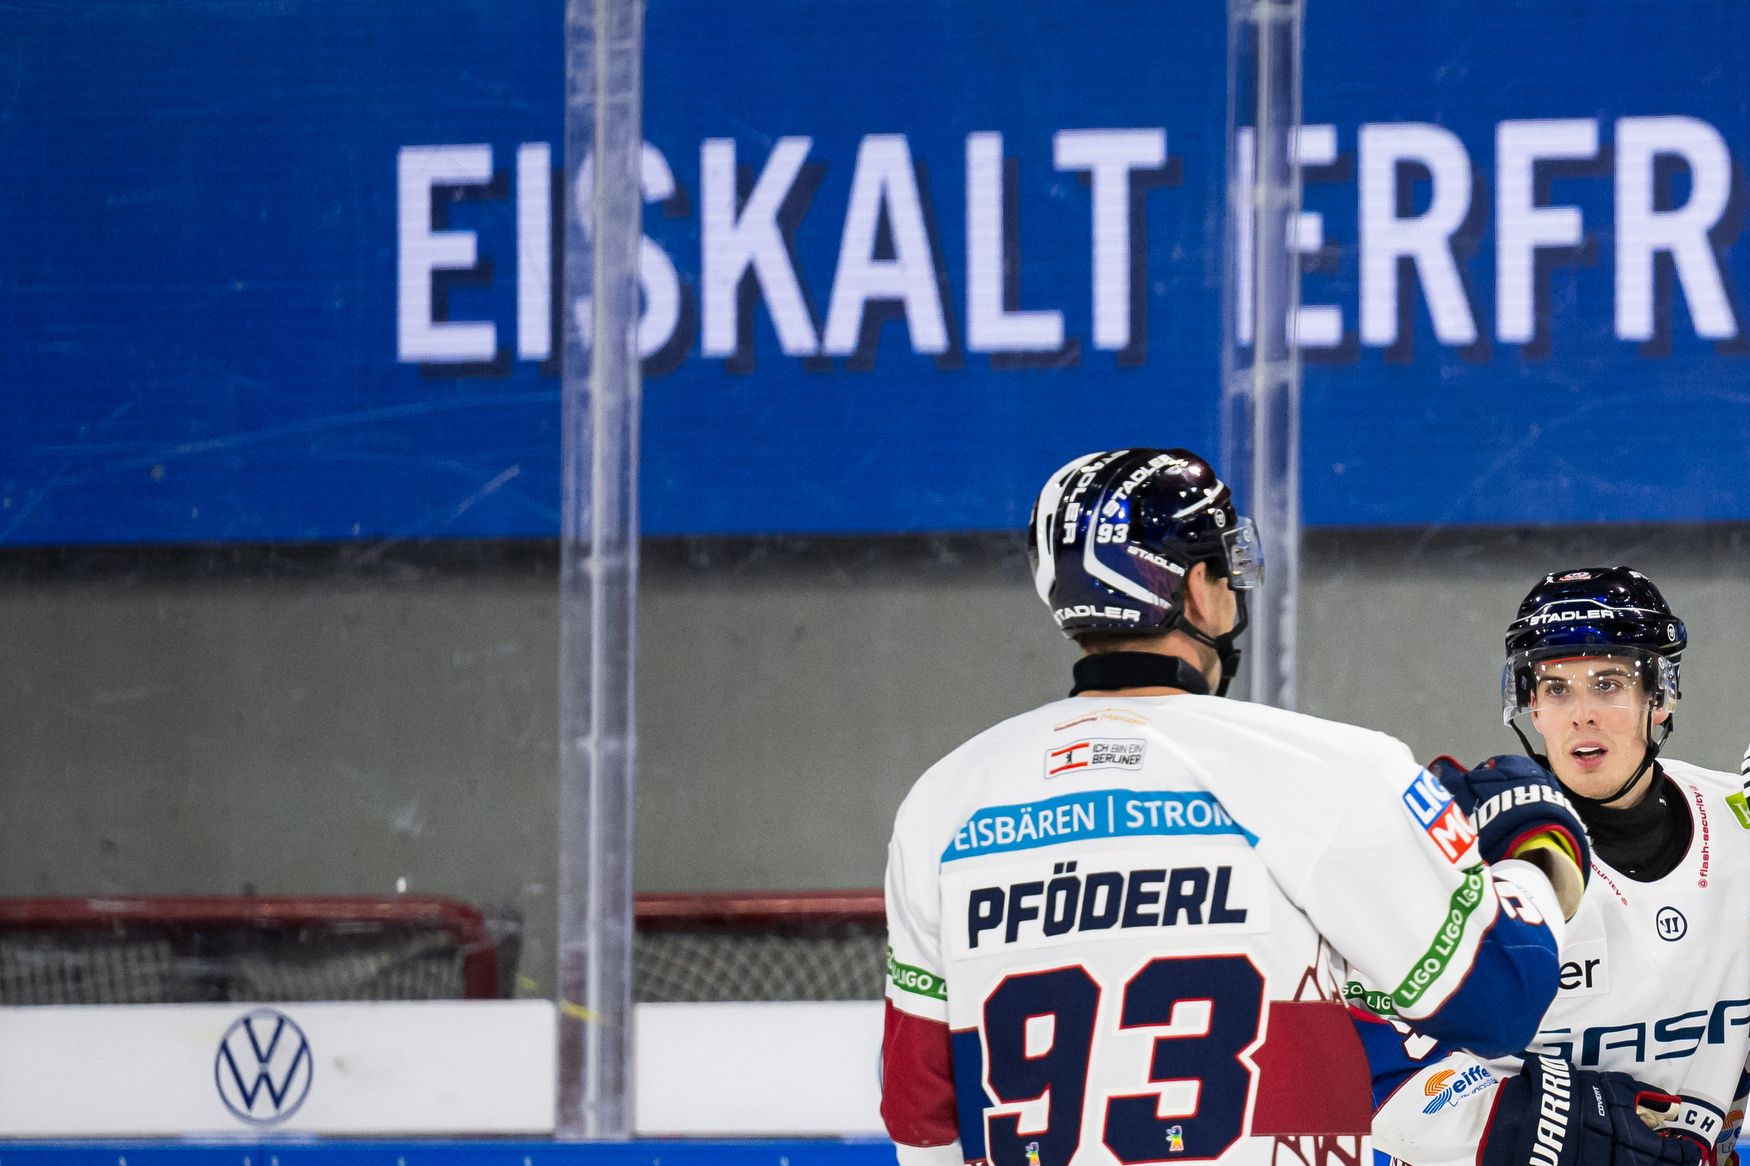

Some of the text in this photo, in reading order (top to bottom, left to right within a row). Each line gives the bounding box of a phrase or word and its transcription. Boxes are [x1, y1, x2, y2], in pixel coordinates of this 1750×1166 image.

[398, 127, 1168, 363] EISKALT
[1096, 524, 1130, 545] 93
[1126, 545, 1187, 577] STADLER
[1530, 609, 1615, 626] STADLER
[1092, 743, 1109, 753] ICH
[1111, 744, 1127, 754] BIN
[1092, 753, 1142, 765] BERLINER
[954, 802, 1096, 851] EISBÄREN
[968, 861, 1248, 949] PFÖDERL
[1435, 909, 1464, 957] LIGO
[1400, 958, 1441, 1001] LIGO
